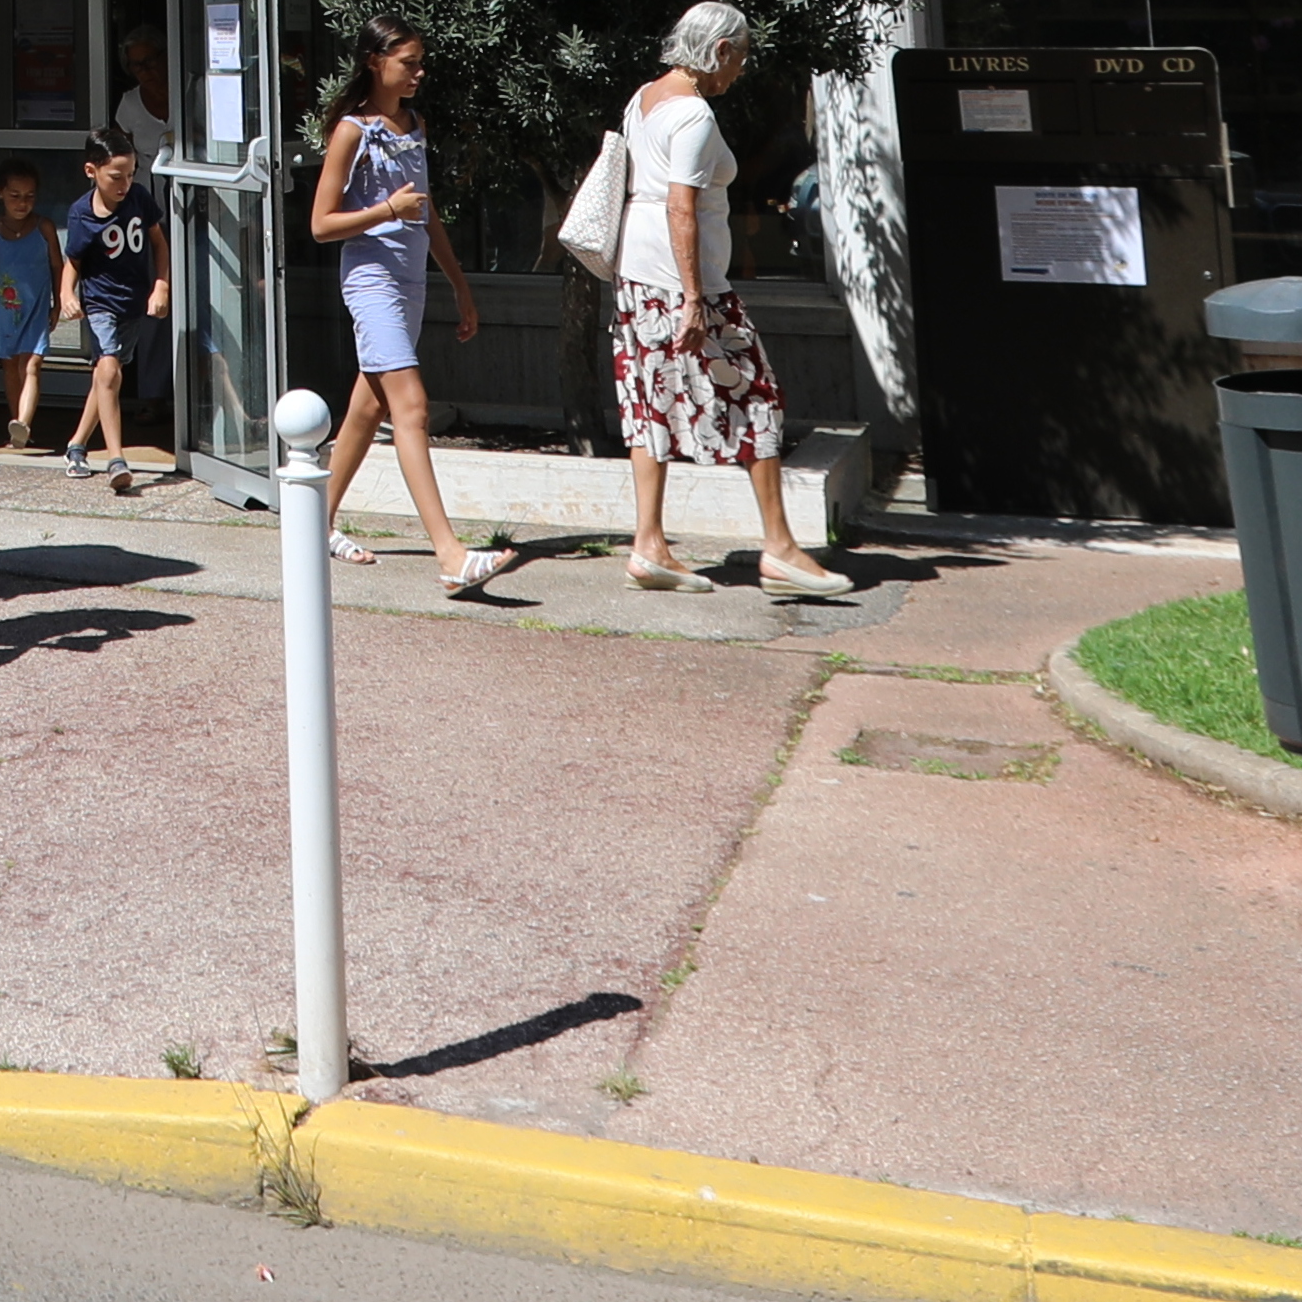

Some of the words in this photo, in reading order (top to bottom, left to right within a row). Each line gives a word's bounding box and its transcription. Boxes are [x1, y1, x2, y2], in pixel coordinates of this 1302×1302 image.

[948, 57, 1030, 72] LIVRES
[1095, 58, 1144, 73] DVD
[1162, 57, 1195, 73] CD
[102, 217, 143, 259] 96
